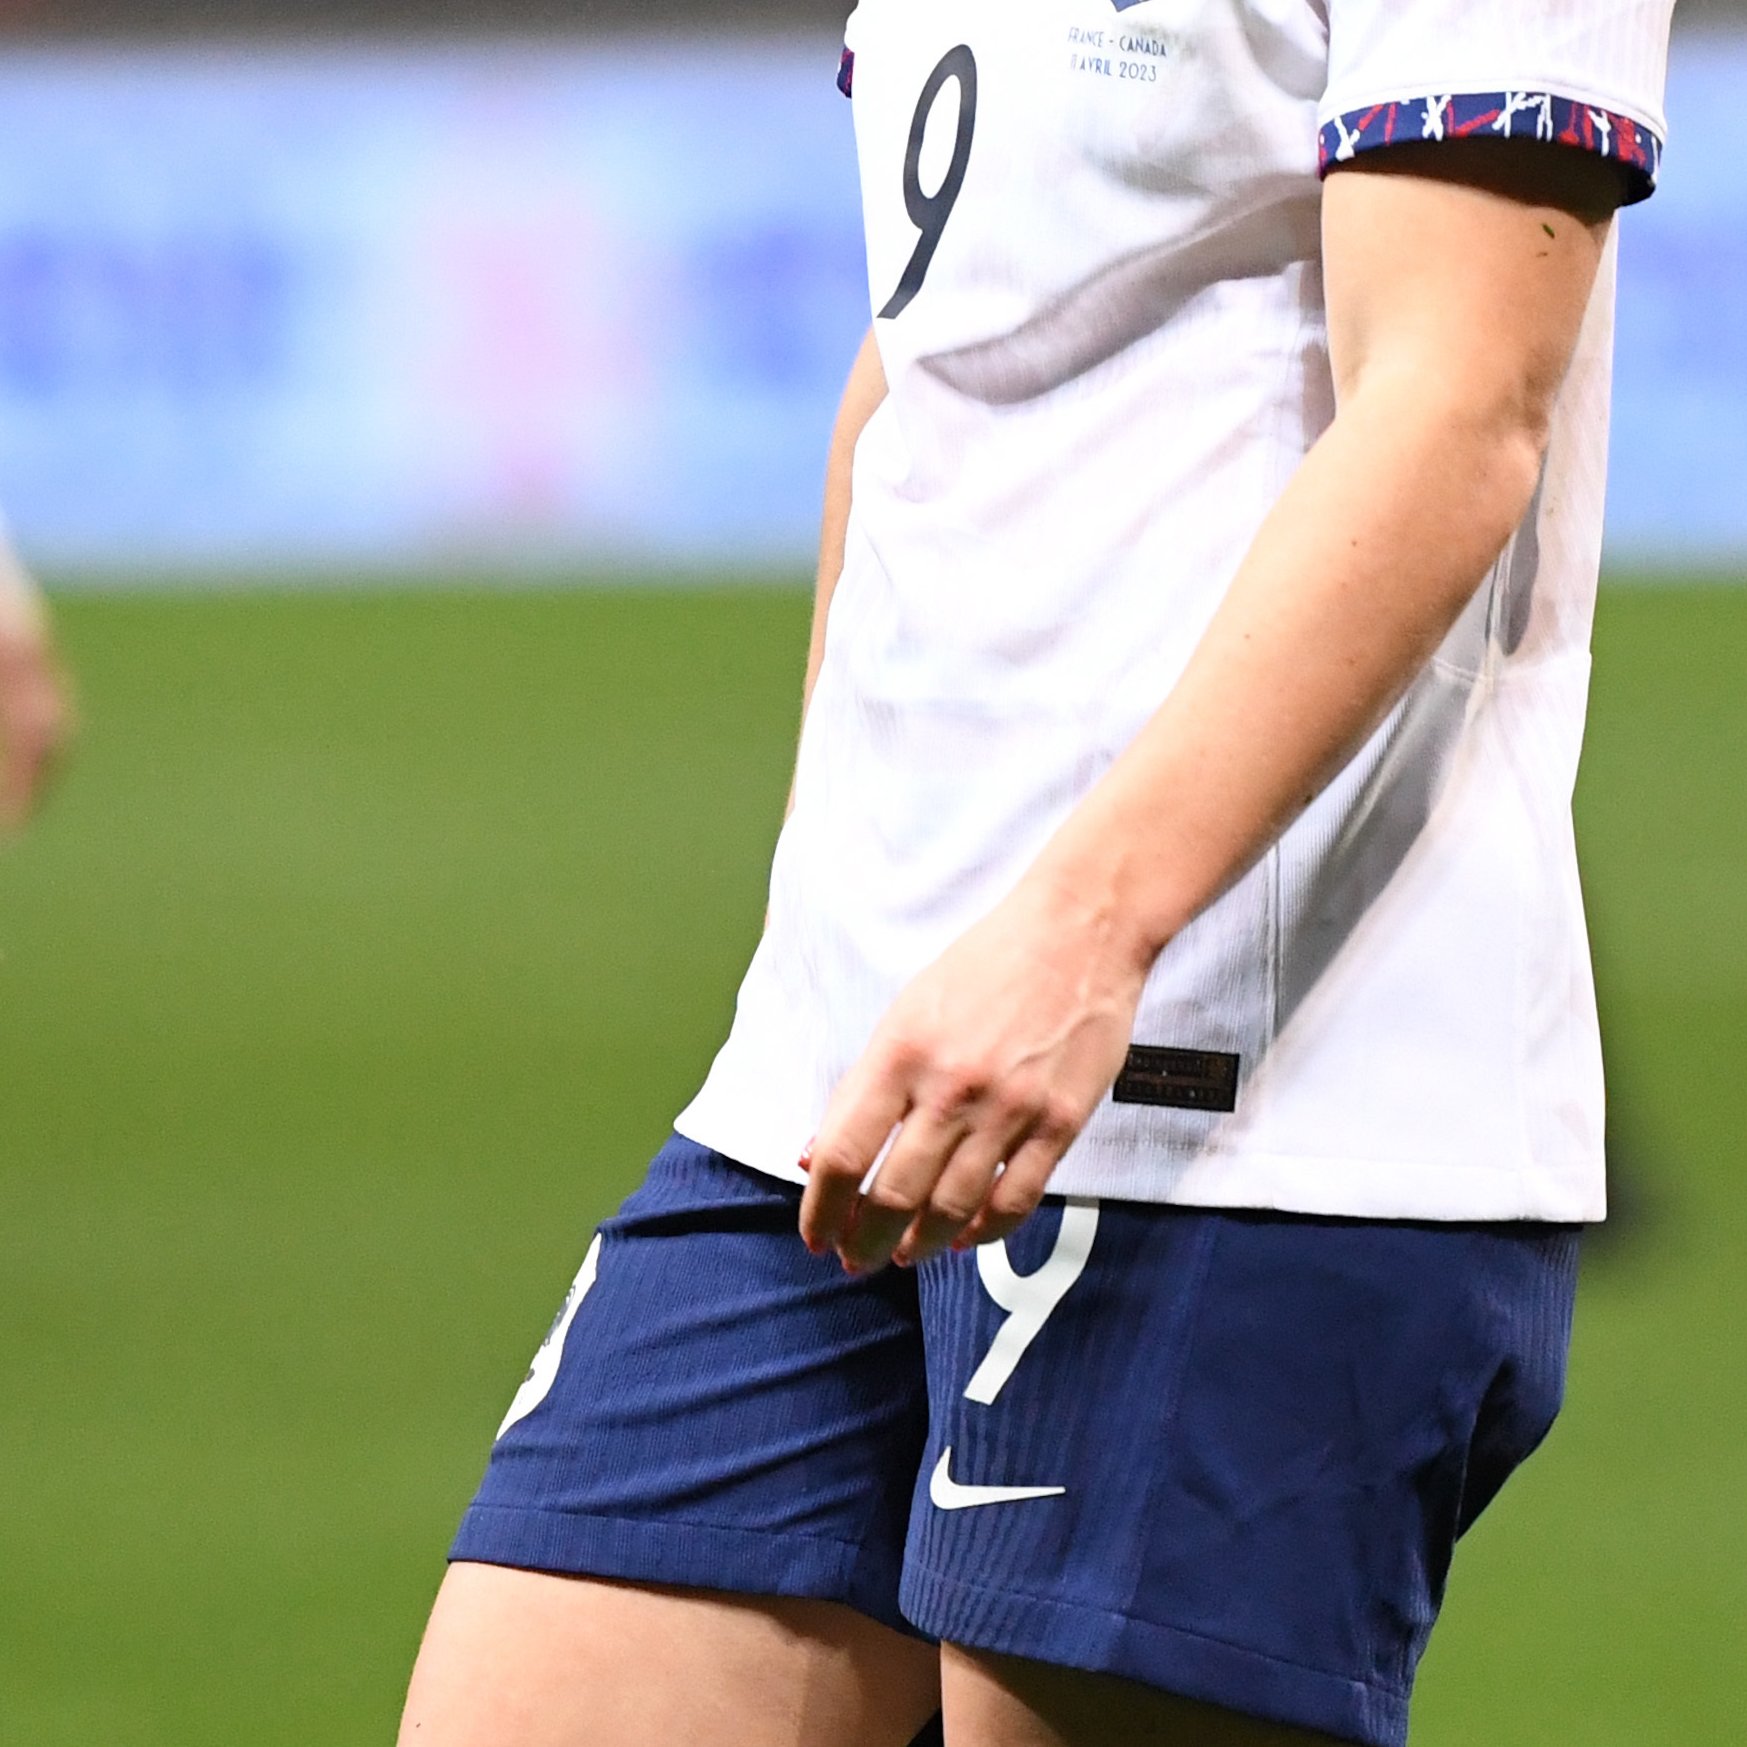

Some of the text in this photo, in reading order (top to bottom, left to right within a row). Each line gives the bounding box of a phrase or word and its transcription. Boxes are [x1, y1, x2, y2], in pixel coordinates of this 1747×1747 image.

[1068, 26, 1105, 48] FRANCE
[1118, 34, 1167, 58] CANADA
[1079, 55, 1112, 77] AVRIL
[1118, 60, 1157, 83] 2023
[875, 43, 979, 321] 9
